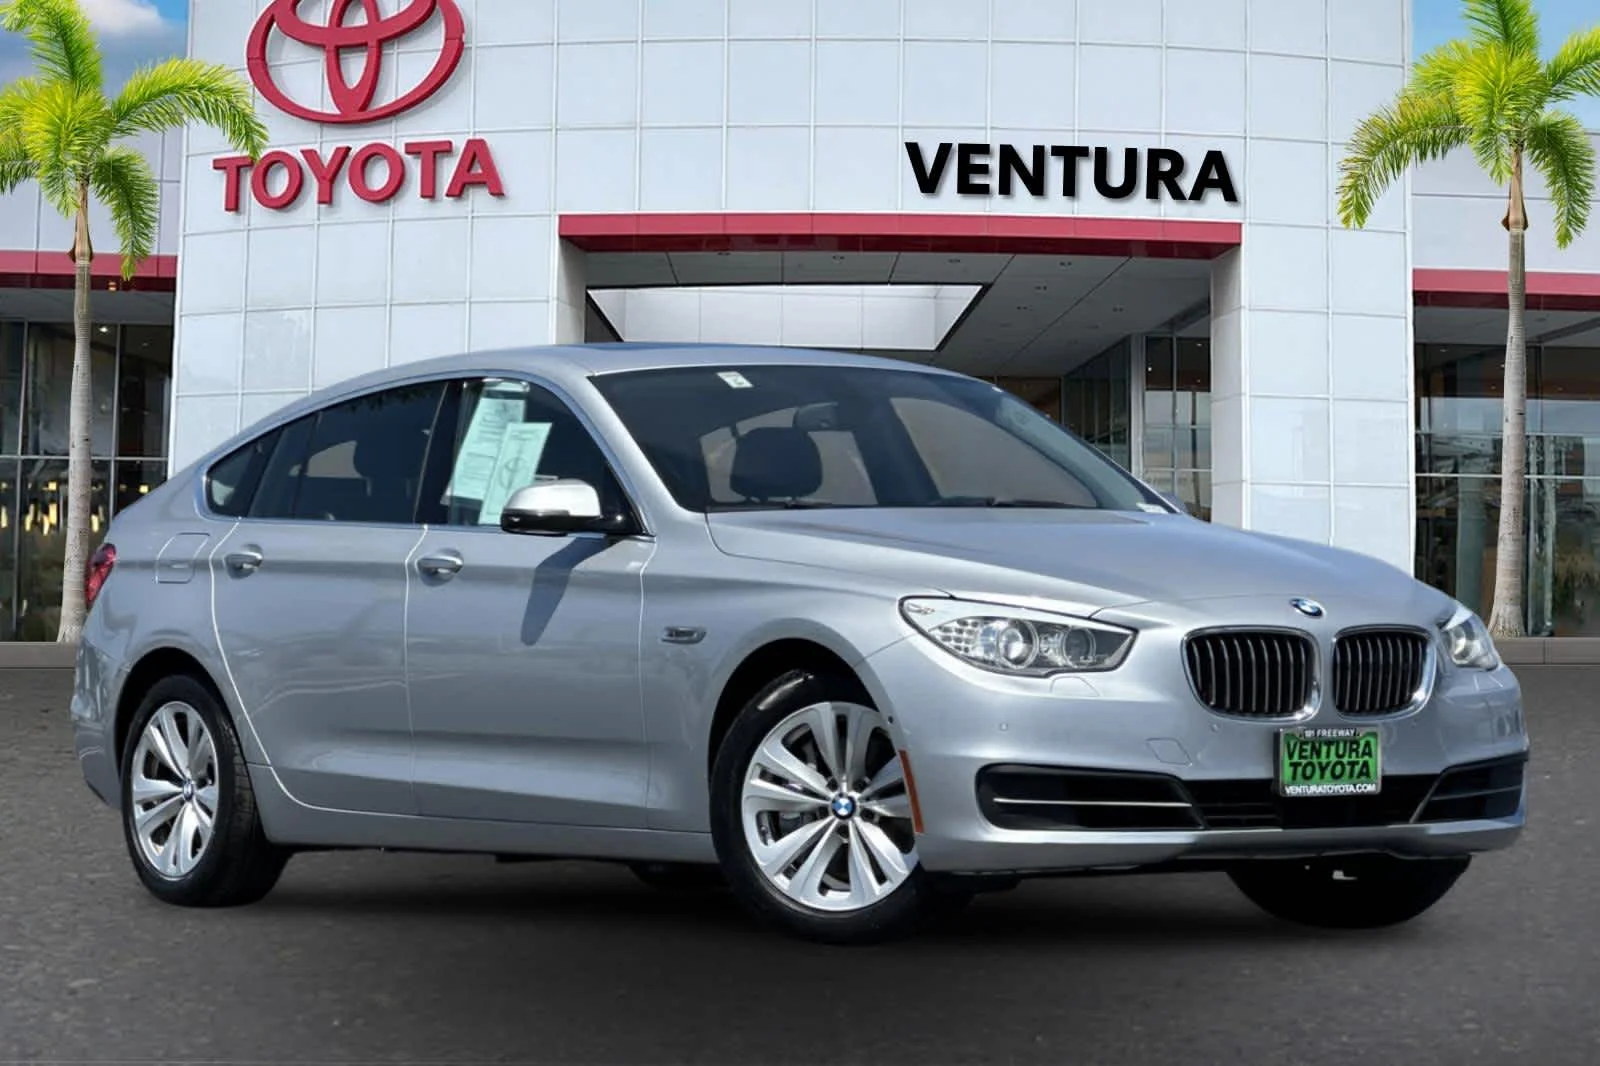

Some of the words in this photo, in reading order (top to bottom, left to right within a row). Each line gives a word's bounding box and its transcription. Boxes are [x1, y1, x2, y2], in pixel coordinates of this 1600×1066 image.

[213, 138, 504, 212] TOYOTA
[904, 142, 1238, 202] VENTURA
[1316, 729, 1355, 737] FREEWAY
[1286, 740, 1373, 760] VENTURA
[1289, 760, 1371, 781] TOYOTA
[1284, 783, 1376, 795] VENTURATOYOTA.COM
